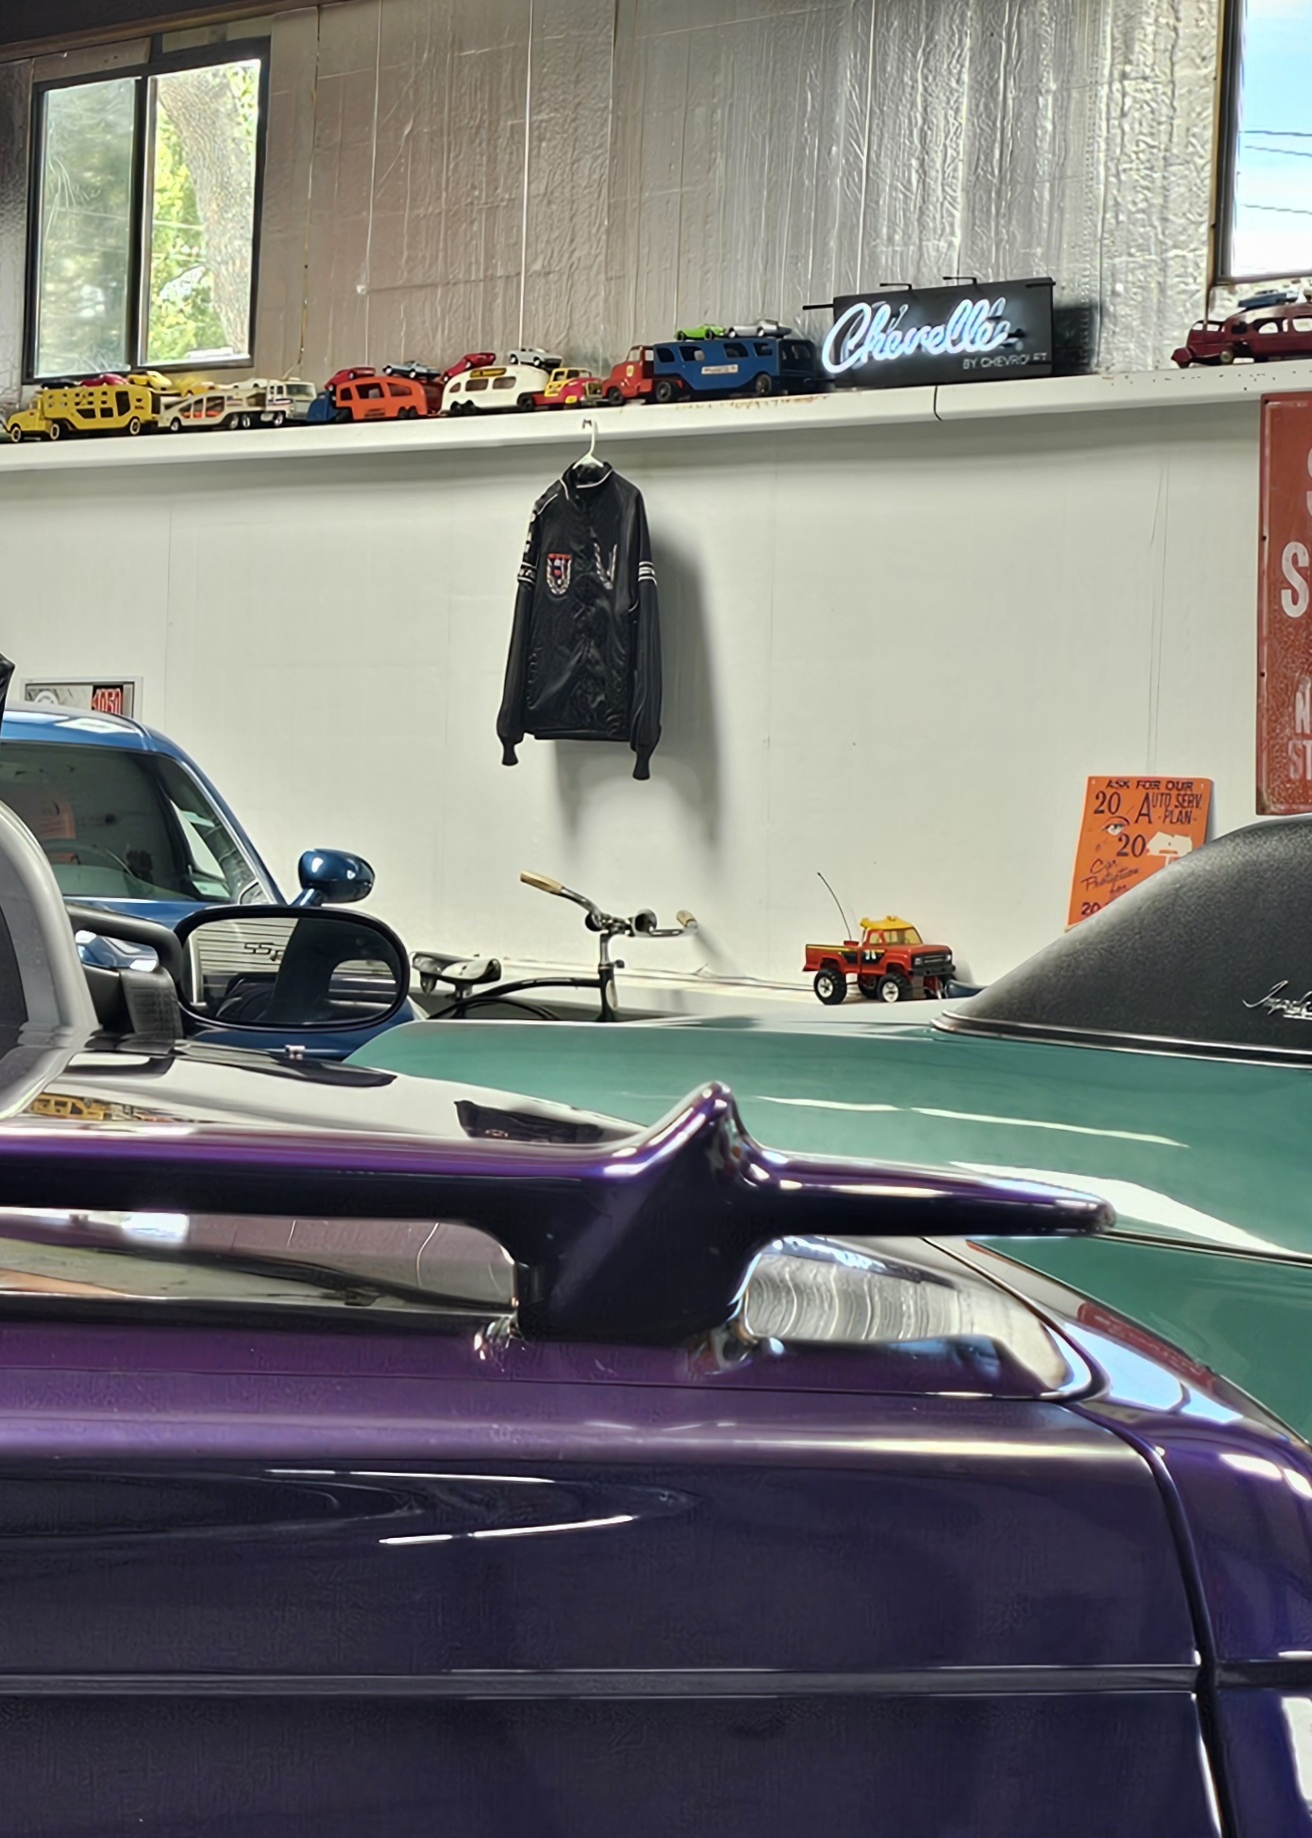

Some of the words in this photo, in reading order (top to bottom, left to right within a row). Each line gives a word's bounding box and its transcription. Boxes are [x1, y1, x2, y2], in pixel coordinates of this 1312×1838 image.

[822, 297, 1011, 374] Chevelle
[963, 358, 978, 370] BY
[980, 352, 1048, 369] CHEVROET
[1105, 780, 1130, 790] ASK
[1135, 780, 1161, 790] FOR
[1165, 781, 1194, 791] OUR
[1093, 790, 1122, 815] 20
[1116, 833, 1146, 858] 20
